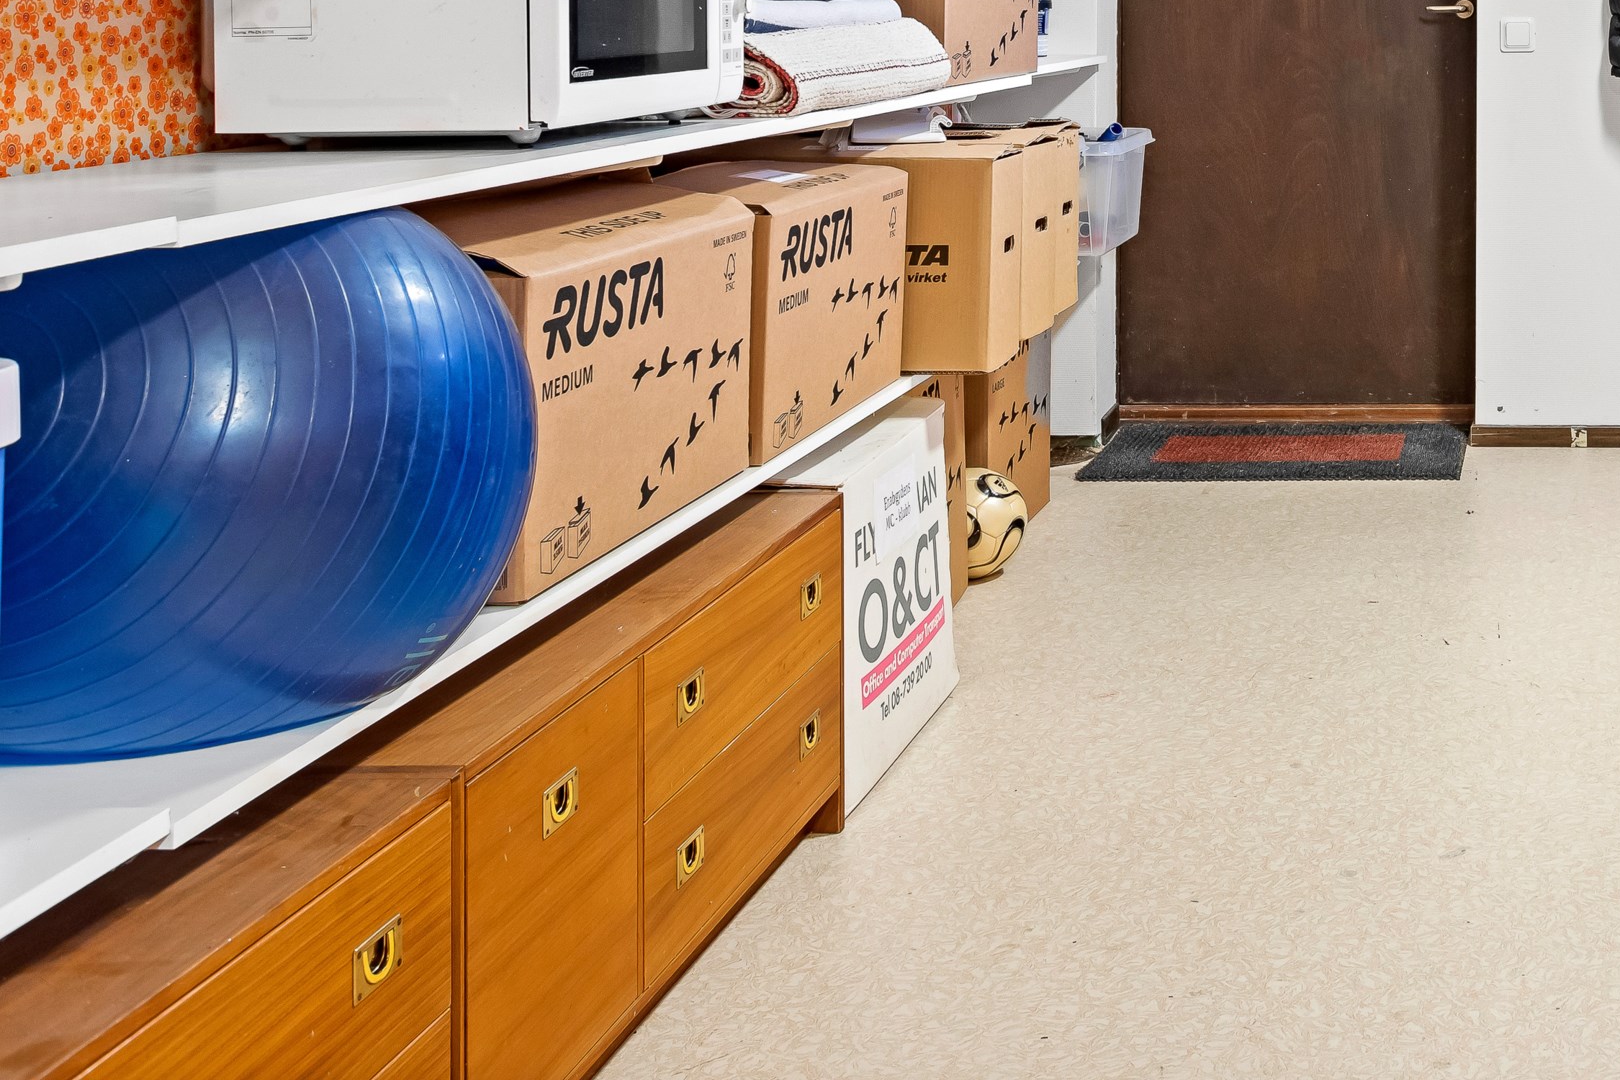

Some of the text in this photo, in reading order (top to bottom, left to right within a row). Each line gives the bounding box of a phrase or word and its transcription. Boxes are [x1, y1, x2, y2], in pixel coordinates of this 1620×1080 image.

[559, 221, 613, 239] THIS
[600, 214, 647, 232] SIDE
[712, 238, 725, 248] MADE
[730, 230, 747, 243] SWEDEN
[781, 206, 853, 282] RUSTA
[542, 256, 664, 361] RUSTA
[725, 280, 736, 293] FSC
[778, 287, 809, 315] MEDIUM
[541, 364, 594, 403] MEDIUM
[858, 520, 940, 664] O&CT
[862, 607, 944, 699] Office and Computer Transport
[880, 651, 933, 721] Tel 08-739 20 00
